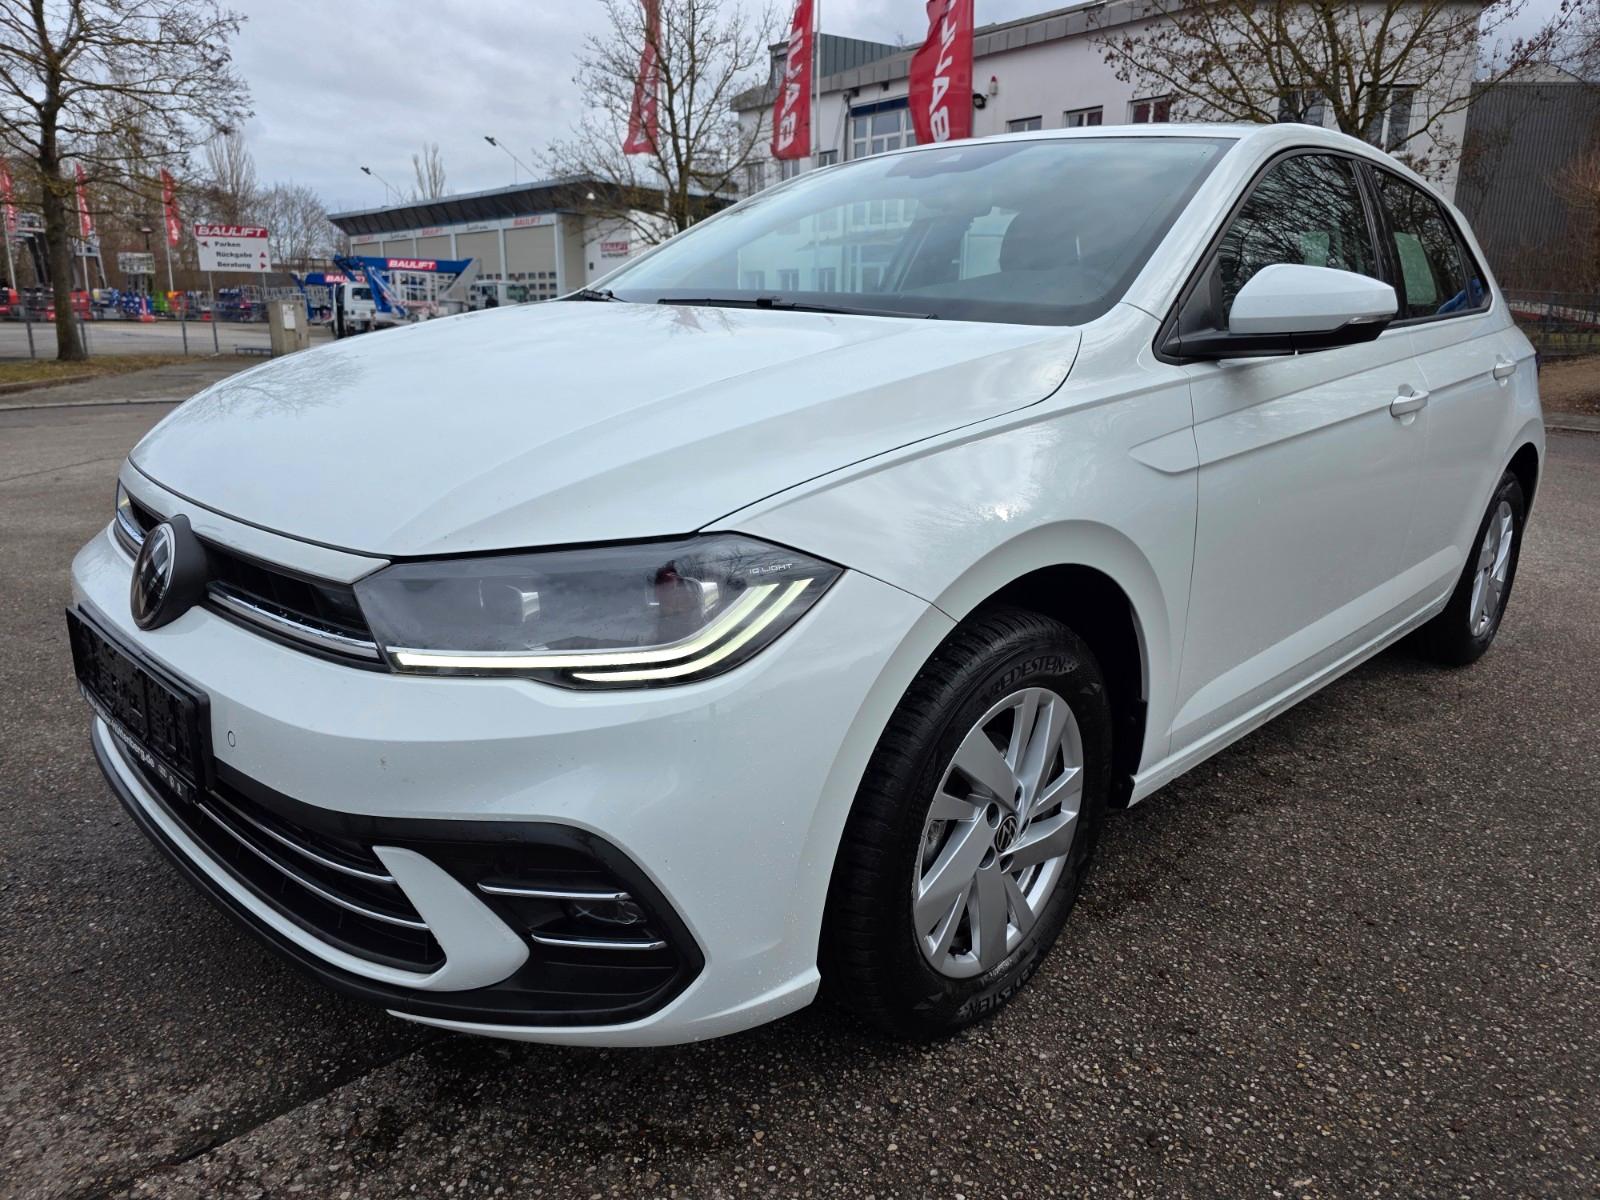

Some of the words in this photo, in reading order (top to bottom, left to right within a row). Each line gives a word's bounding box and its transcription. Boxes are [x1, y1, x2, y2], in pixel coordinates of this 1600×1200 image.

[198, 226, 265, 237] BAULIFT
[216, 251, 253, 259] Rückgabe
[217, 261, 252, 269] Beratung
[387, 260, 436, 269] BAULIFT
